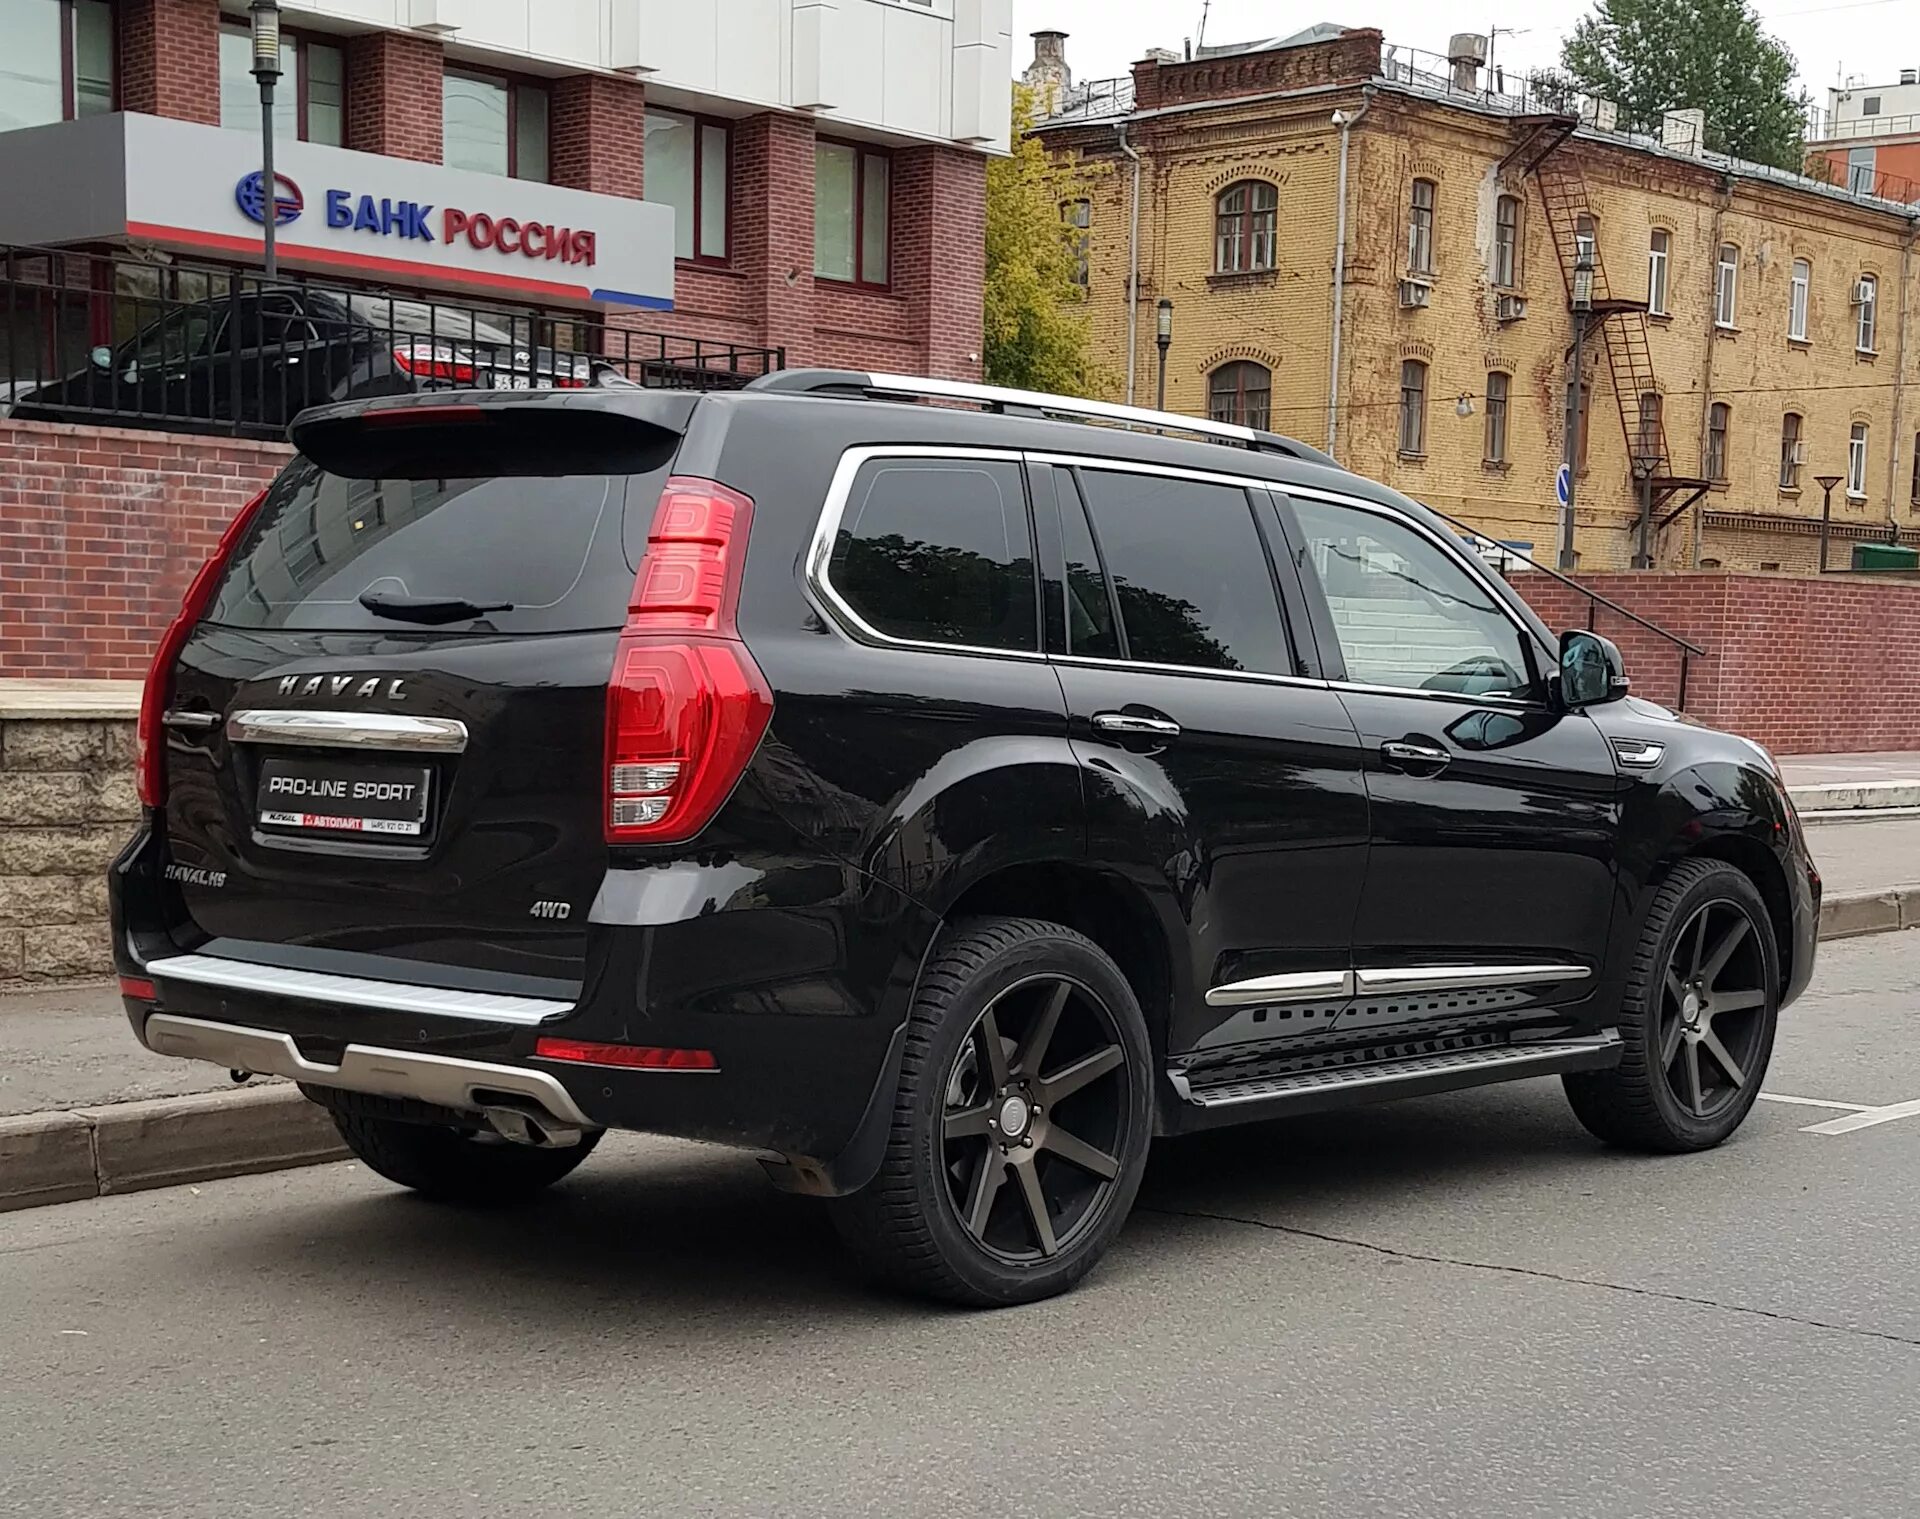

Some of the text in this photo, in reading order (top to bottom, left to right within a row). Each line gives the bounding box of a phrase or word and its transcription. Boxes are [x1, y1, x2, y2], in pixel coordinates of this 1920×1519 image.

[326, 189, 597, 266] БАНК РОССИЯ
[278, 675, 408, 700] HAVAL
[269, 777, 416, 801] PRO-LINE SPORT
[530, 900, 571, 919] 4WD
